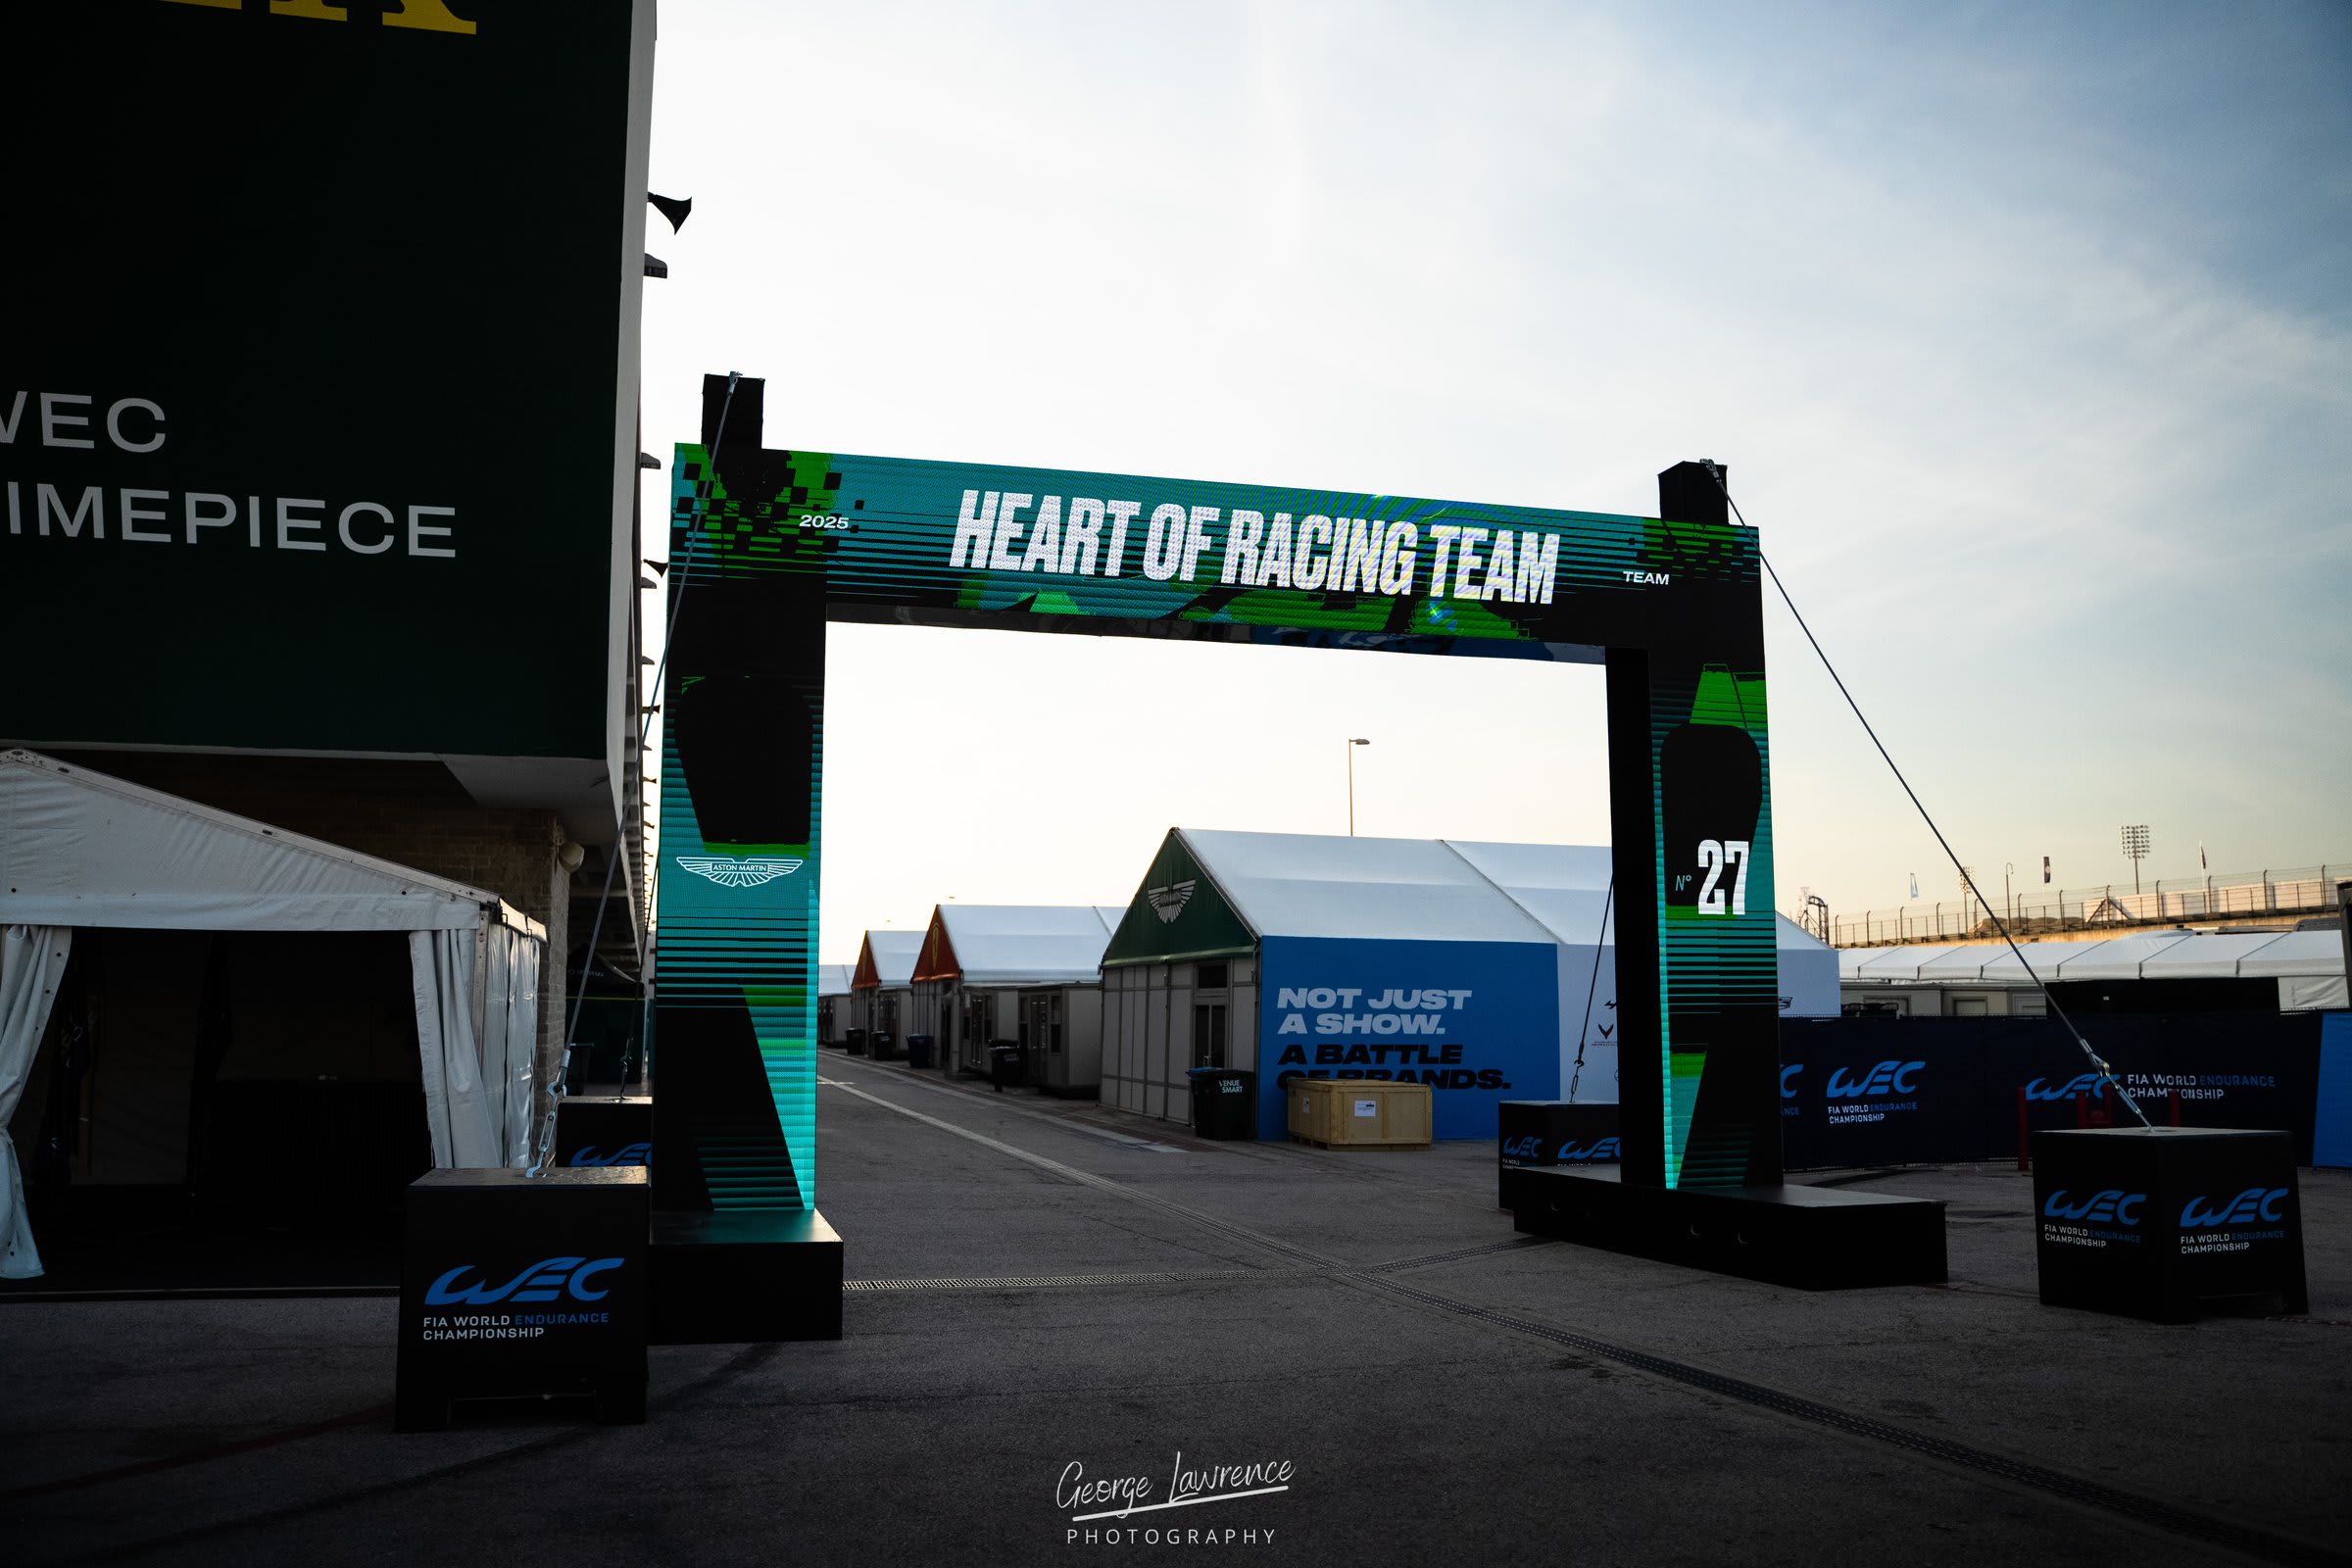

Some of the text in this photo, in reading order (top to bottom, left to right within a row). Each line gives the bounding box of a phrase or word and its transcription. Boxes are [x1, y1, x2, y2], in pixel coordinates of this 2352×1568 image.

[7, 481, 457, 558] IMEPIECE
[799, 514, 849, 530] 2025
[949, 489, 1560, 605] HEART OF RACING TEAM
[1623, 571, 1670, 585] TEAM
[1697, 839, 1748, 914] 27
[1277, 988, 1473, 1010] NOT JUST
[1277, 1013, 1446, 1035] A SHOW.
[1277, 1044, 1464, 1065] A BATTLE
[1826, 1059, 1927, 1099] WEC
[2127, 1074, 2276, 1088] FIA WORLD ENDURANCE
[2127, 1088, 2225, 1100] CHAMONSHIP
[1828, 1102, 1918, 1114] FIA WORLD ENDURANCE
[1829, 1113, 1886, 1124] CHAMPIONSHIP
[1502, 1136, 1544, 1158] WEC
[2043, 1189, 2148, 1226] WEC
[2180, 1187, 2290, 1228] WEC
[2044, 1224, 2141, 1244] FIA WORLD ENDURANCE
[2044, 1234, 2107, 1249] CHAMPIONSHIP
[2180, 1230, 2285, 1244] FIA WORLD ENDURANCE
[2180, 1242, 2250, 1254] CHAMPIONSHIP
[422, 1255, 627, 1306] WEC
[423, 1312, 610, 1328] FIA WORLD ENDURANCE
[422, 1327, 545, 1341] CHAMPIONSHIP
